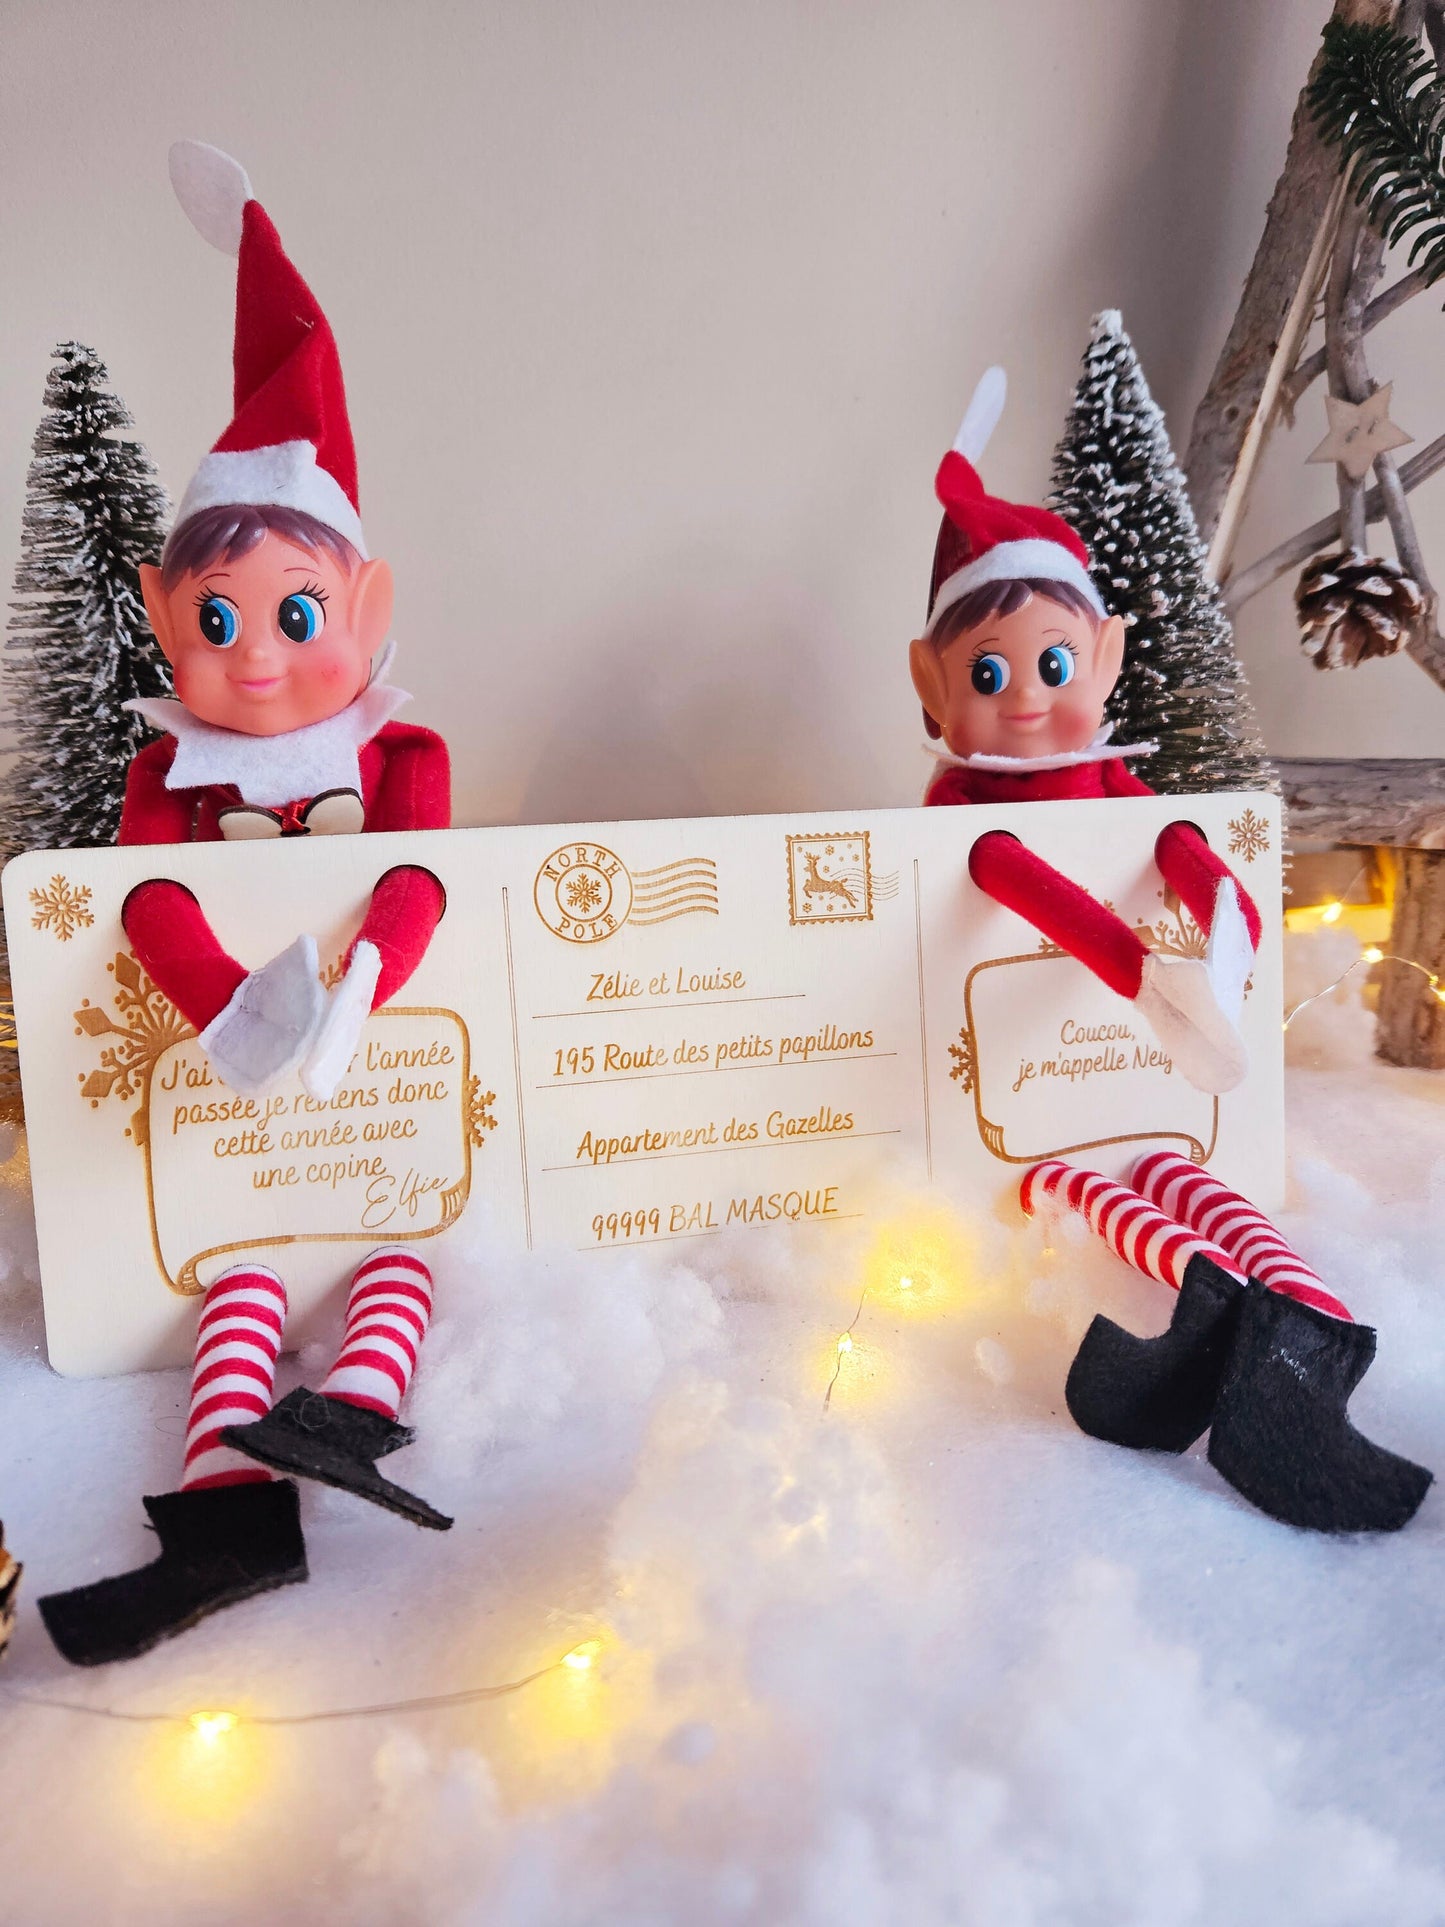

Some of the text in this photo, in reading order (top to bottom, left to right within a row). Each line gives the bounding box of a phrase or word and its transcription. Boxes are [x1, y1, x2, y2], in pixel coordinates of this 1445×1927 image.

[543, 846, 623, 882] NORTH
[553, 914, 618, 939] POLE
[586, 966, 747, 1001] Zélie et Louise
[552, 1023, 874, 1077] 195 Route des petits papillons
[1060, 1019, 1136, 1046] Coucou,
[161, 1059, 213, 1091] J'ai
[366, 1041, 455, 1072] l'année
[1012, 1058, 1037, 1092] je
[1040, 1046, 1128, 1082] m'appelle
[173, 1096, 260, 1135] passée
[257, 1097, 289, 1131] je
[388, 1077, 449, 1105] donc
[213, 1117, 418, 1158] cette année avec
[576, 1105, 855, 1165] Appartement des Gazelles
[253, 1154, 387, 1190] une copine
[361, 1168, 449, 1228] Elfie
[592, 1186, 840, 1241] 99999 BAL MASQUE
